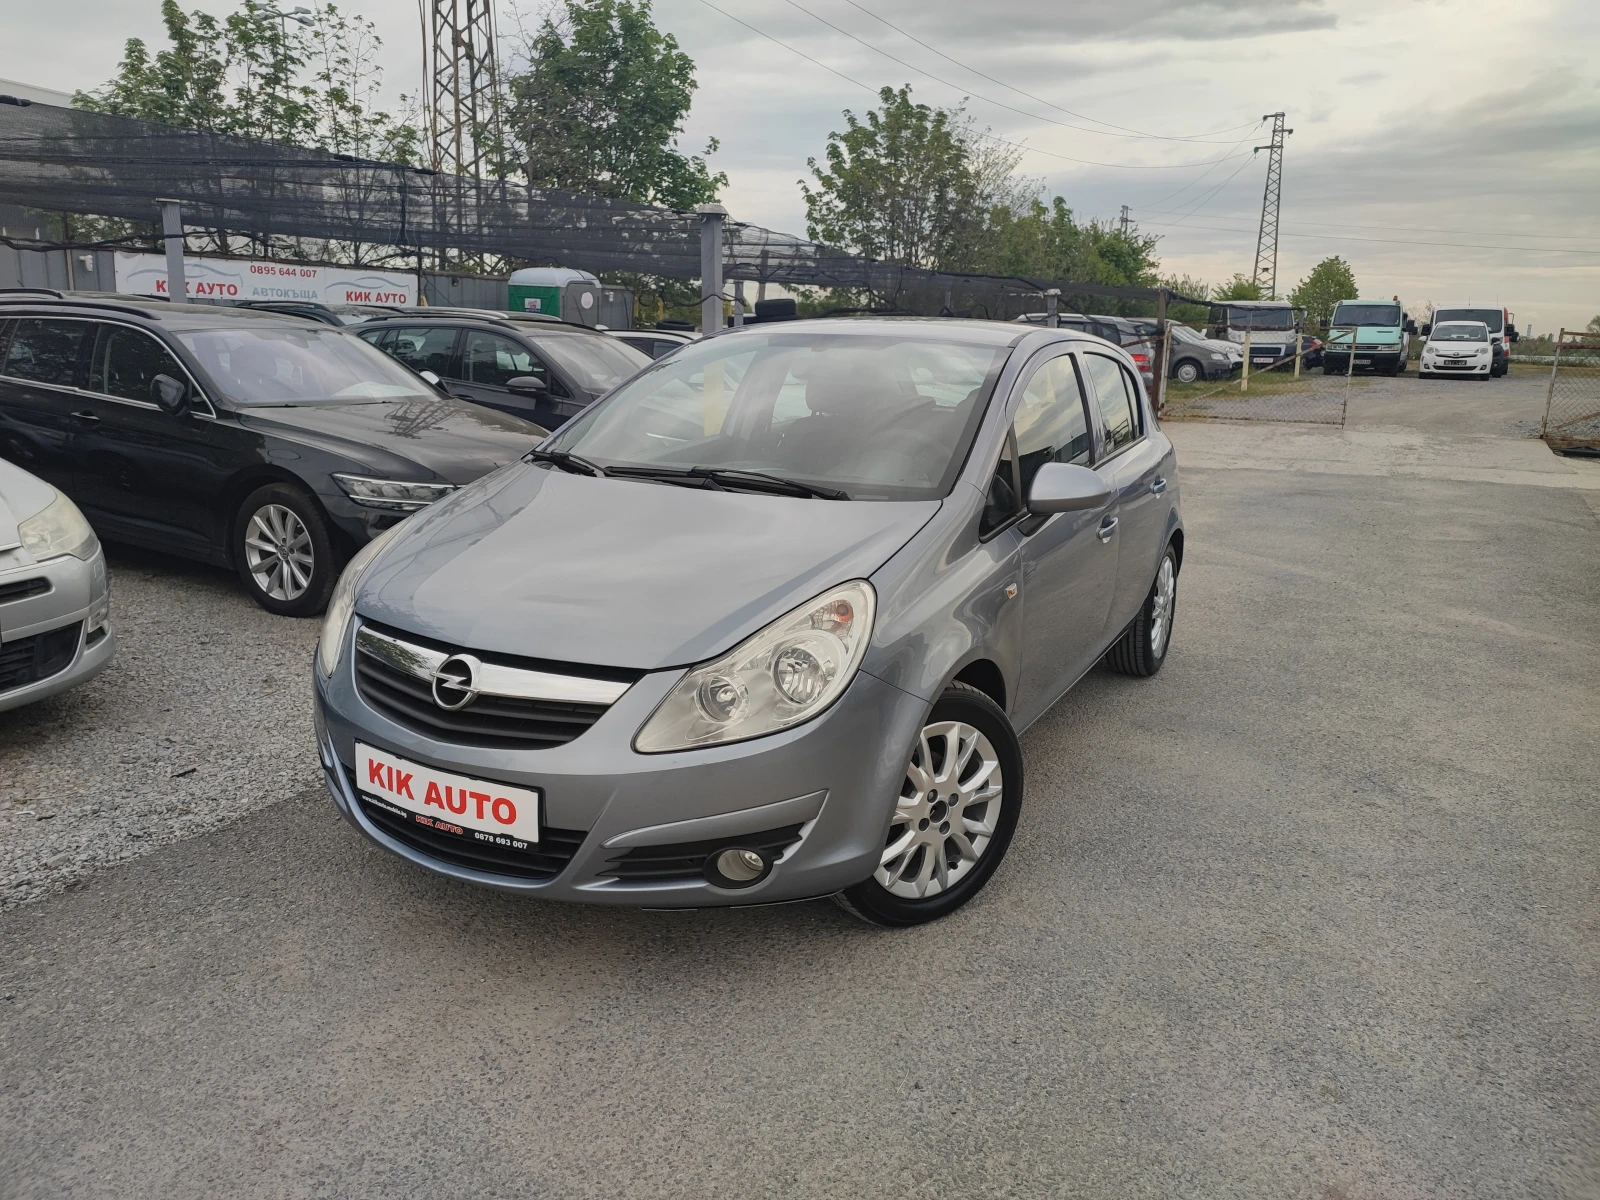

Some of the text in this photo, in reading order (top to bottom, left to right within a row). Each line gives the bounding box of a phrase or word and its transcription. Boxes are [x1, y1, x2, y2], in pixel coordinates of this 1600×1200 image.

[250, 265, 317, 278] 0895 644 007
[196, 282, 238, 296] АУТО
[252, 287, 318, 300] АВТОКЪЩА
[346, 291, 407, 304] КИК АУТО
[368, 758, 517, 826] KIK AUTO
[415, 814, 463, 835] KIK AUTO
[474, 832, 528, 849] 0878 693 007
